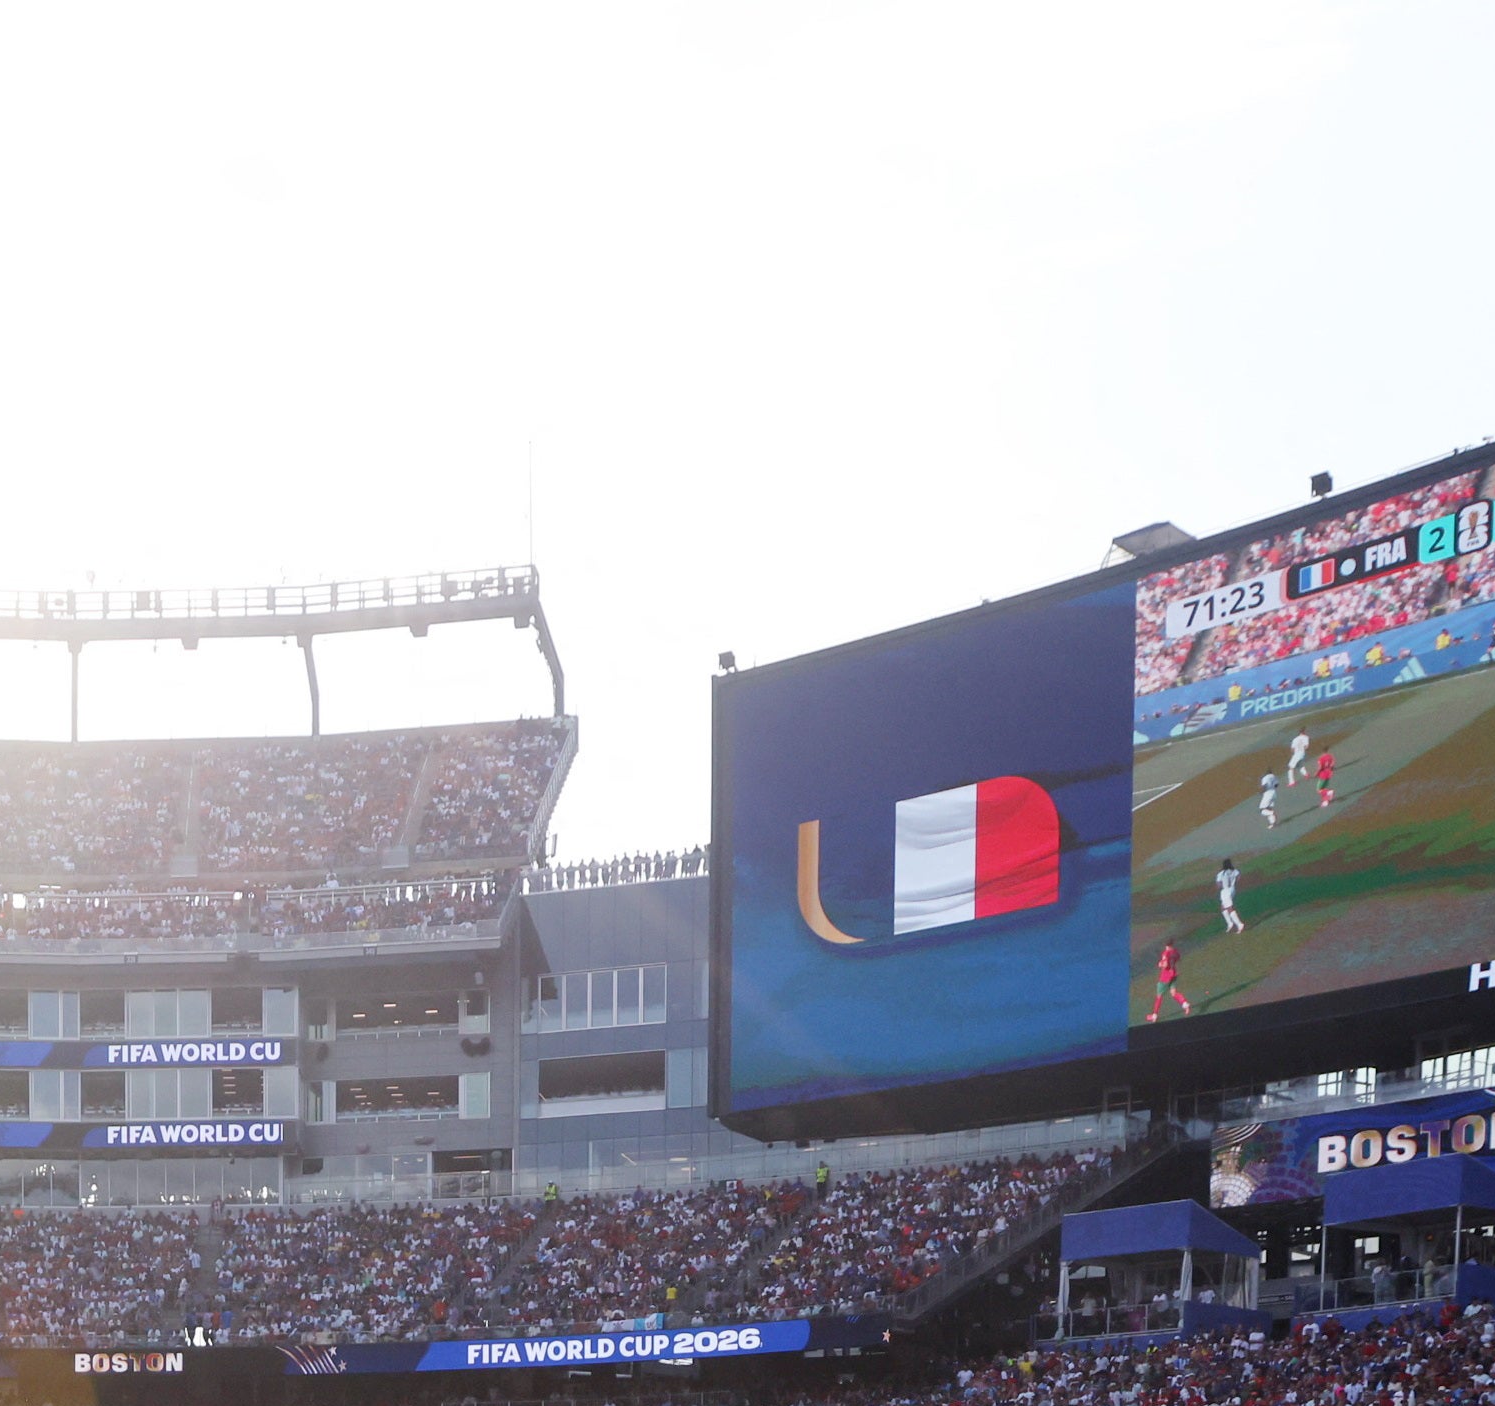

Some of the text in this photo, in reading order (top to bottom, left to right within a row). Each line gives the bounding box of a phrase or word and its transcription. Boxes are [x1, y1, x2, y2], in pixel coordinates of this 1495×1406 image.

[1182, 527, 1445, 628] 71:23 FRA 2
[1240, 676, 1354, 717] PREDATOR
[108, 1042, 281, 1063] FIFA WORLD CU
[107, 1123, 283, 1144] FIFA WORLD CU
[467, 1328, 761, 1365] FIFA WORLD CUP 2026
[74, 1352, 184, 1373] BOSTON
